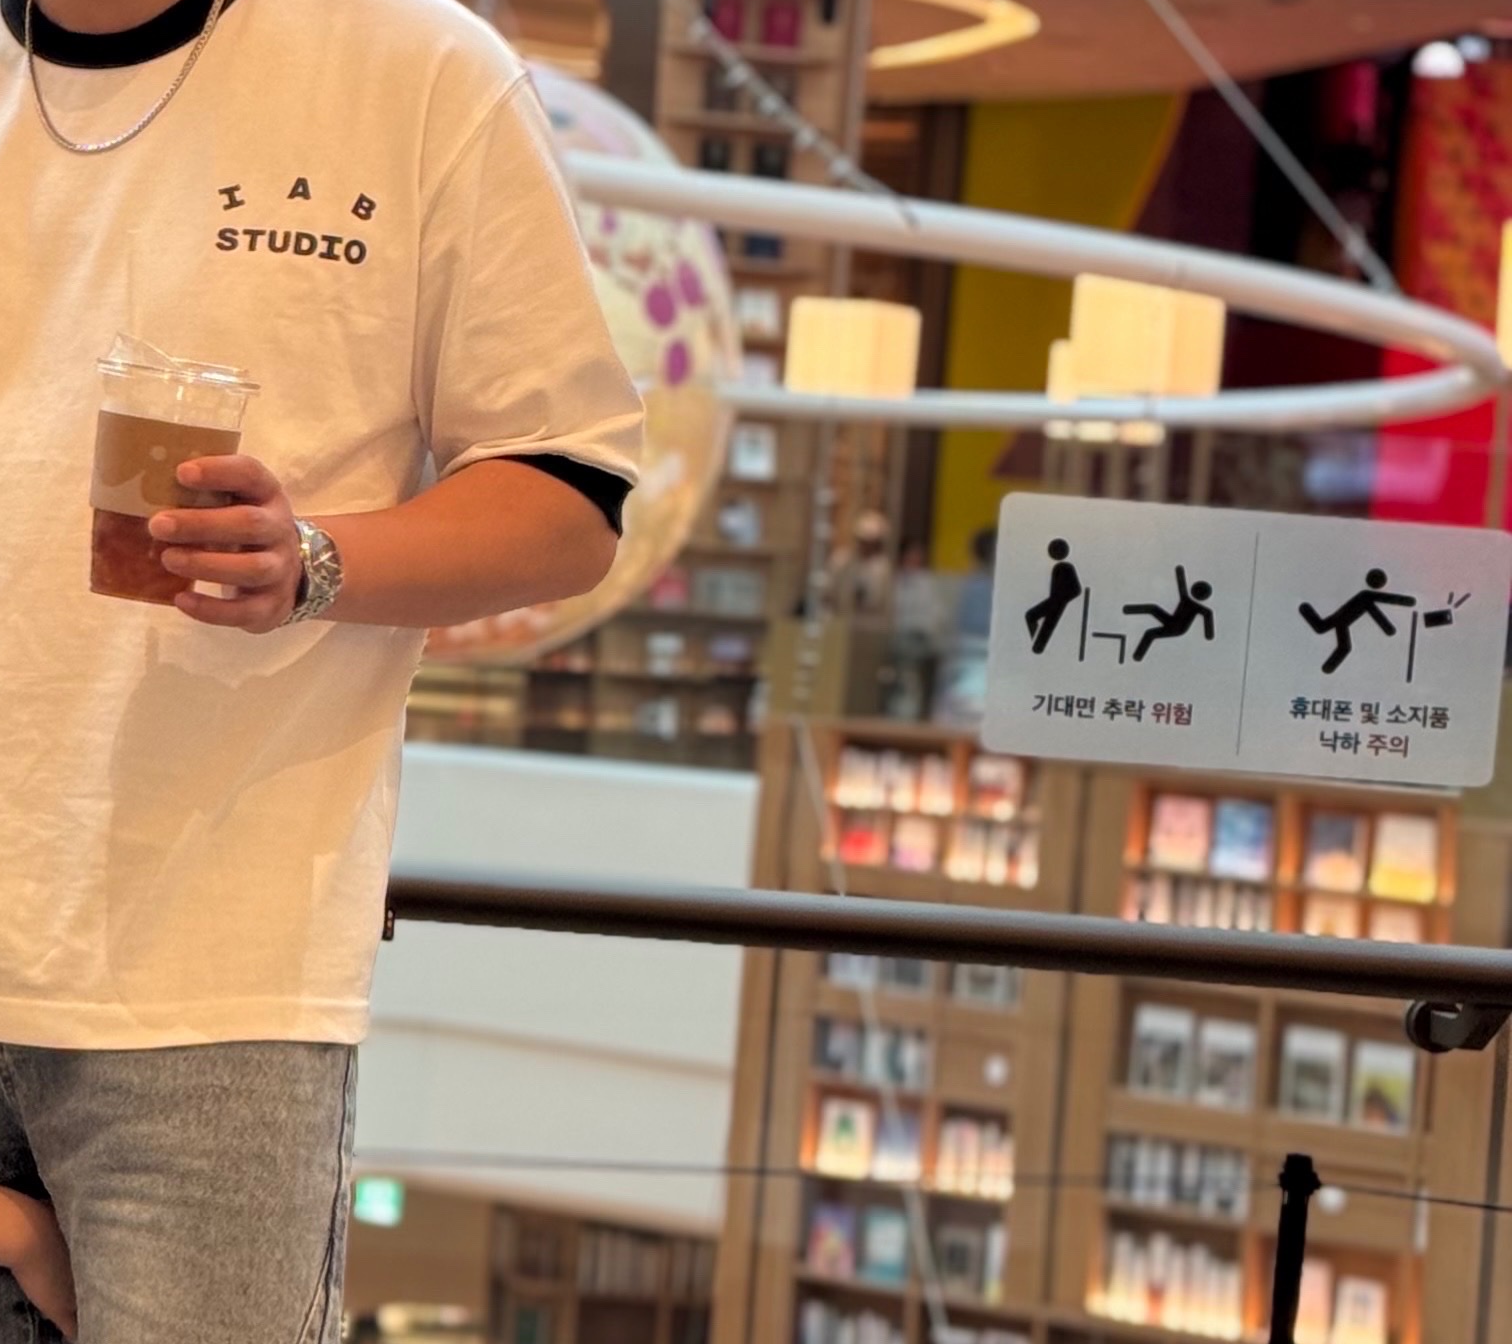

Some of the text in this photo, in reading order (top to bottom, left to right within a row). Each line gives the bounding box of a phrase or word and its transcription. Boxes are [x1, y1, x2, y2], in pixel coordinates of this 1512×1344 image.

[215, 227, 367, 265] STUDIO
[1031, 694, 1193, 726] 기대면 추락 위험
[1289, 696, 1450, 730] 휴대폰 및 소지품
[1319, 730, 1409, 758] 낙하 주의
